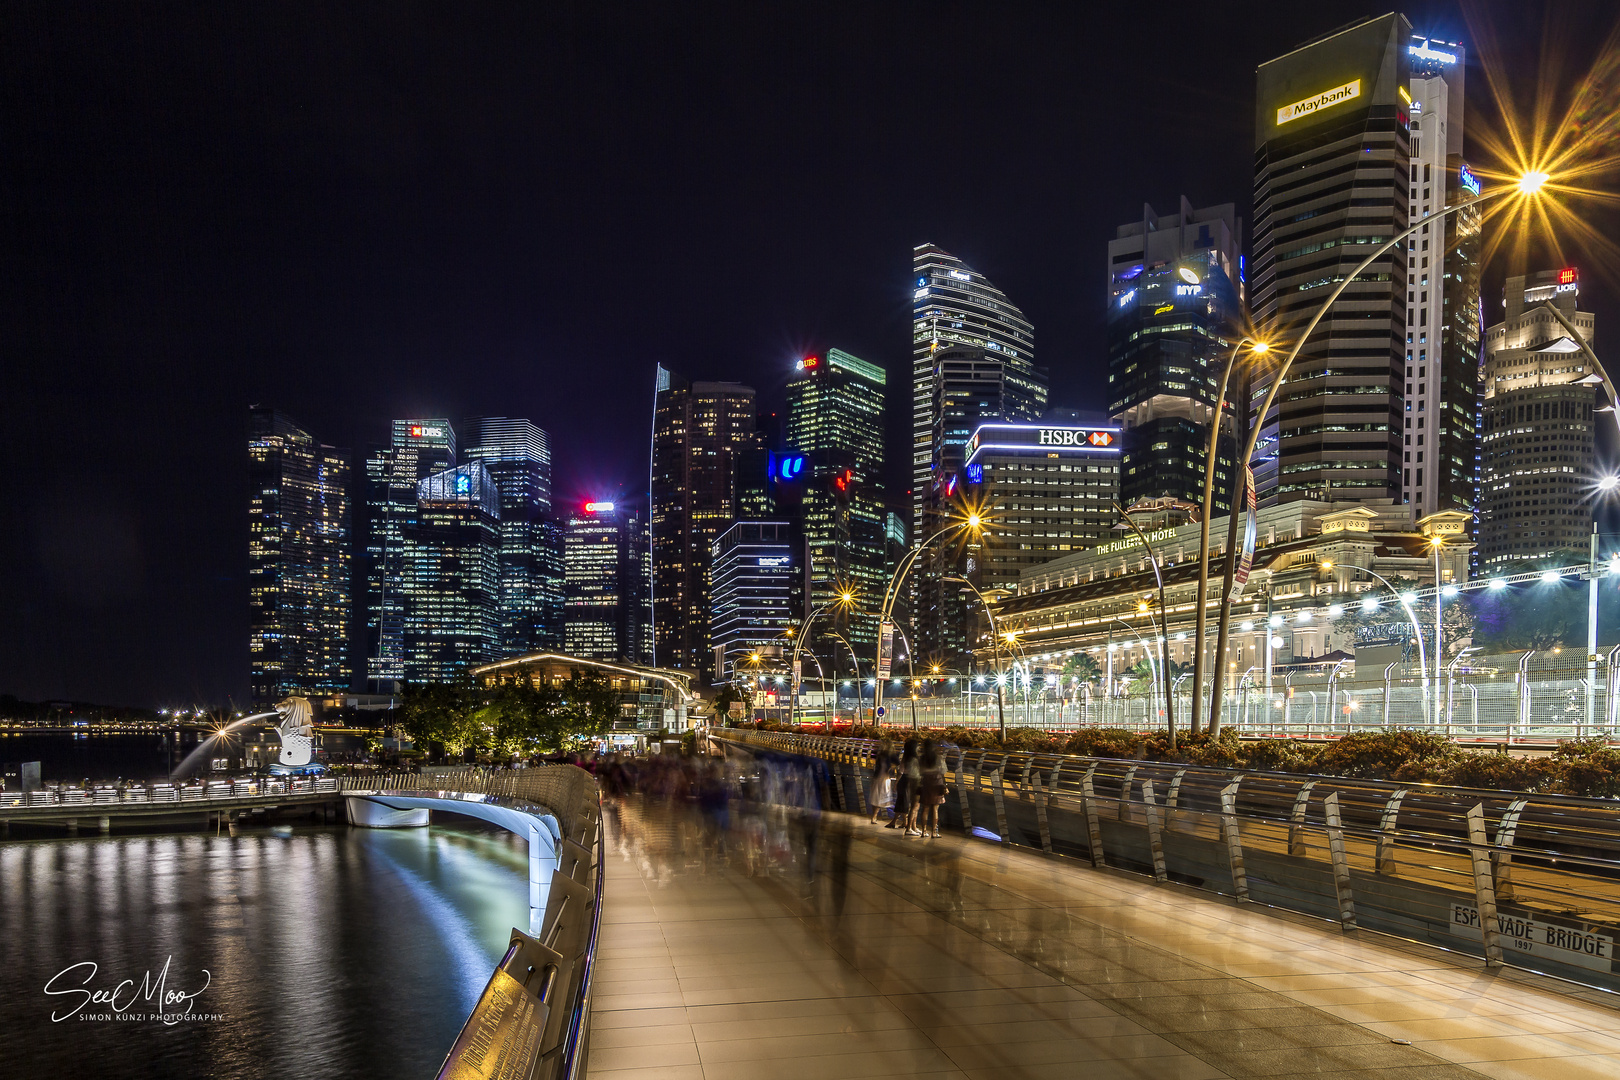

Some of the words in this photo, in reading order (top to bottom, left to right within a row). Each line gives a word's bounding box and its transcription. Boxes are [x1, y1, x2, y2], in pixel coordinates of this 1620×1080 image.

[1294, 86, 1353, 115] Maybank
[1177, 285, 1202, 296] MYP
[1557, 282, 1577, 293] UOB
[804, 357, 817, 368] UBS
[422, 427, 442, 437] DBS
[1039, 429, 1086, 446] HSBC
[1097, 544, 1115, 555] THE
[1151, 527, 1177, 543] HOTEL
[1454, 905, 1534, 940] ESPNADE
[1546, 926, 1606, 957] BRIDGE
[1514, 939, 1533, 951] 1997
[460, 1026, 494, 1075] JUBILEE
